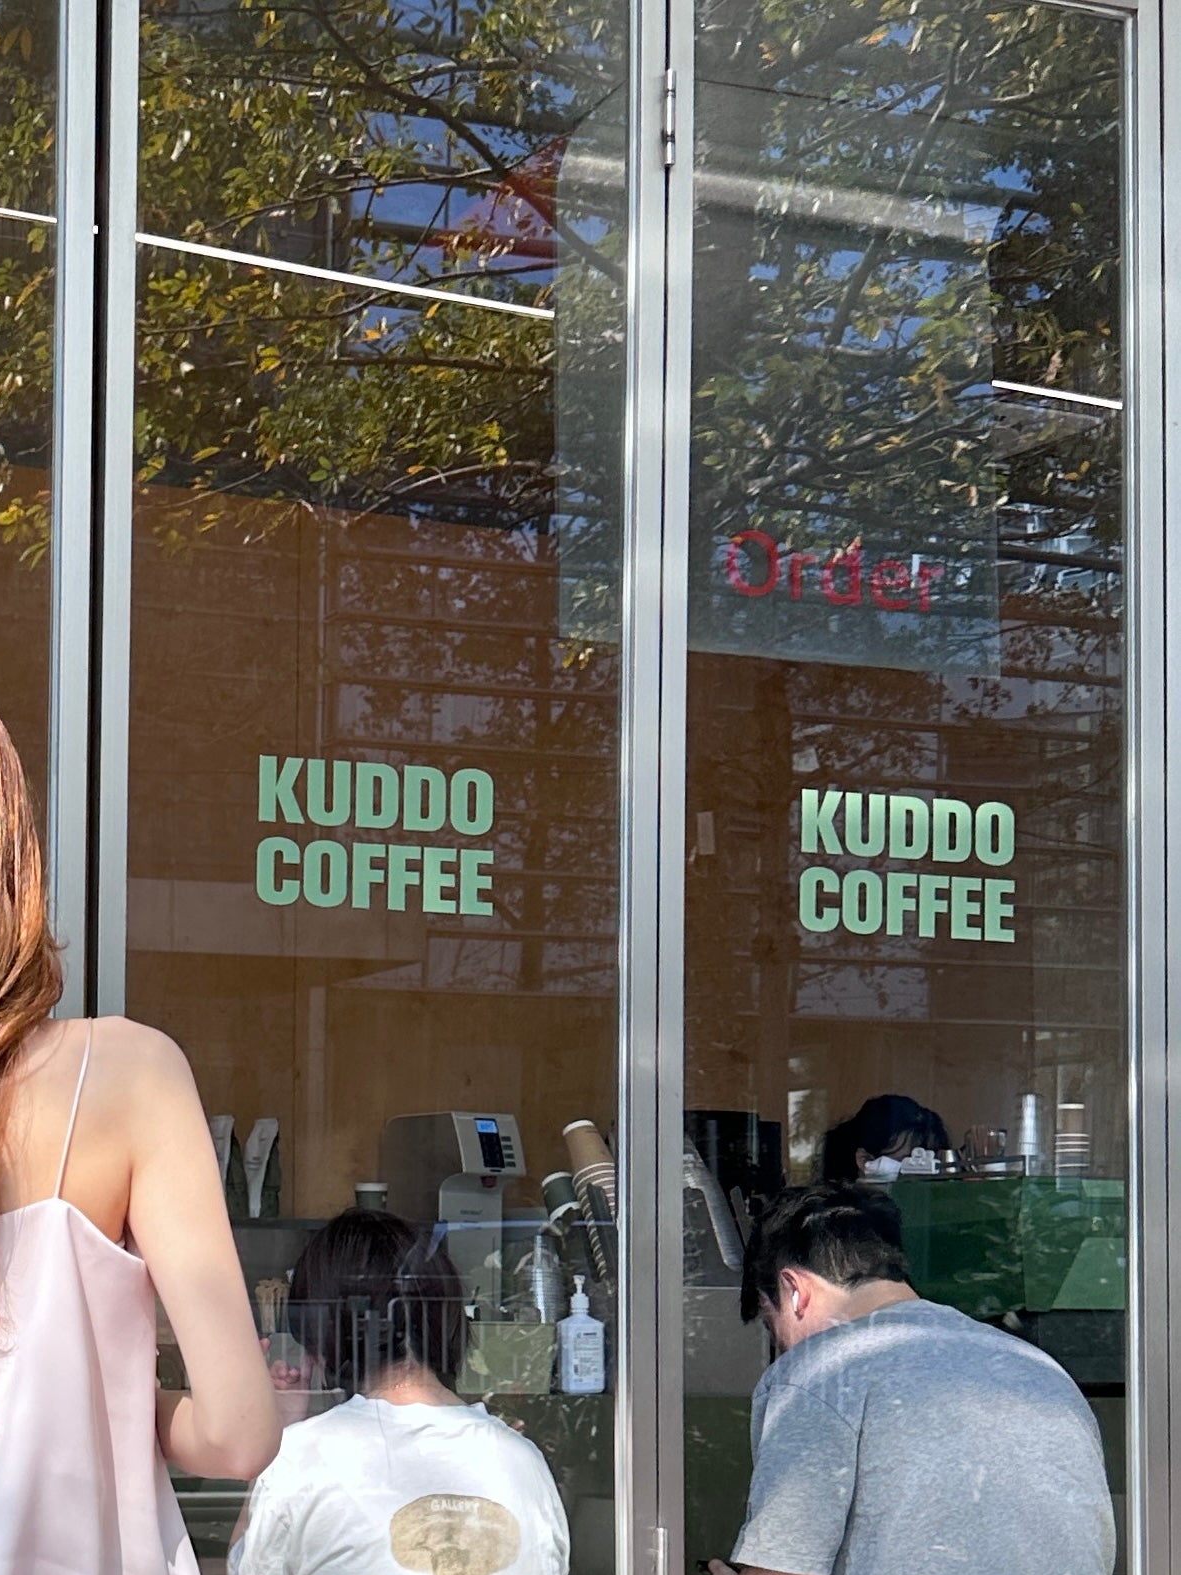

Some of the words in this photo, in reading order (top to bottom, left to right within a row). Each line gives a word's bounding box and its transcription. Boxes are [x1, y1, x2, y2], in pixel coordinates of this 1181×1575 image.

[726, 529, 945, 612] Order
[257, 754, 495, 836] KUDDO
[799, 788, 1016, 867] KUDDO
[255, 836, 495, 917] COFFEE
[798, 866, 1016, 943] COFFEE
